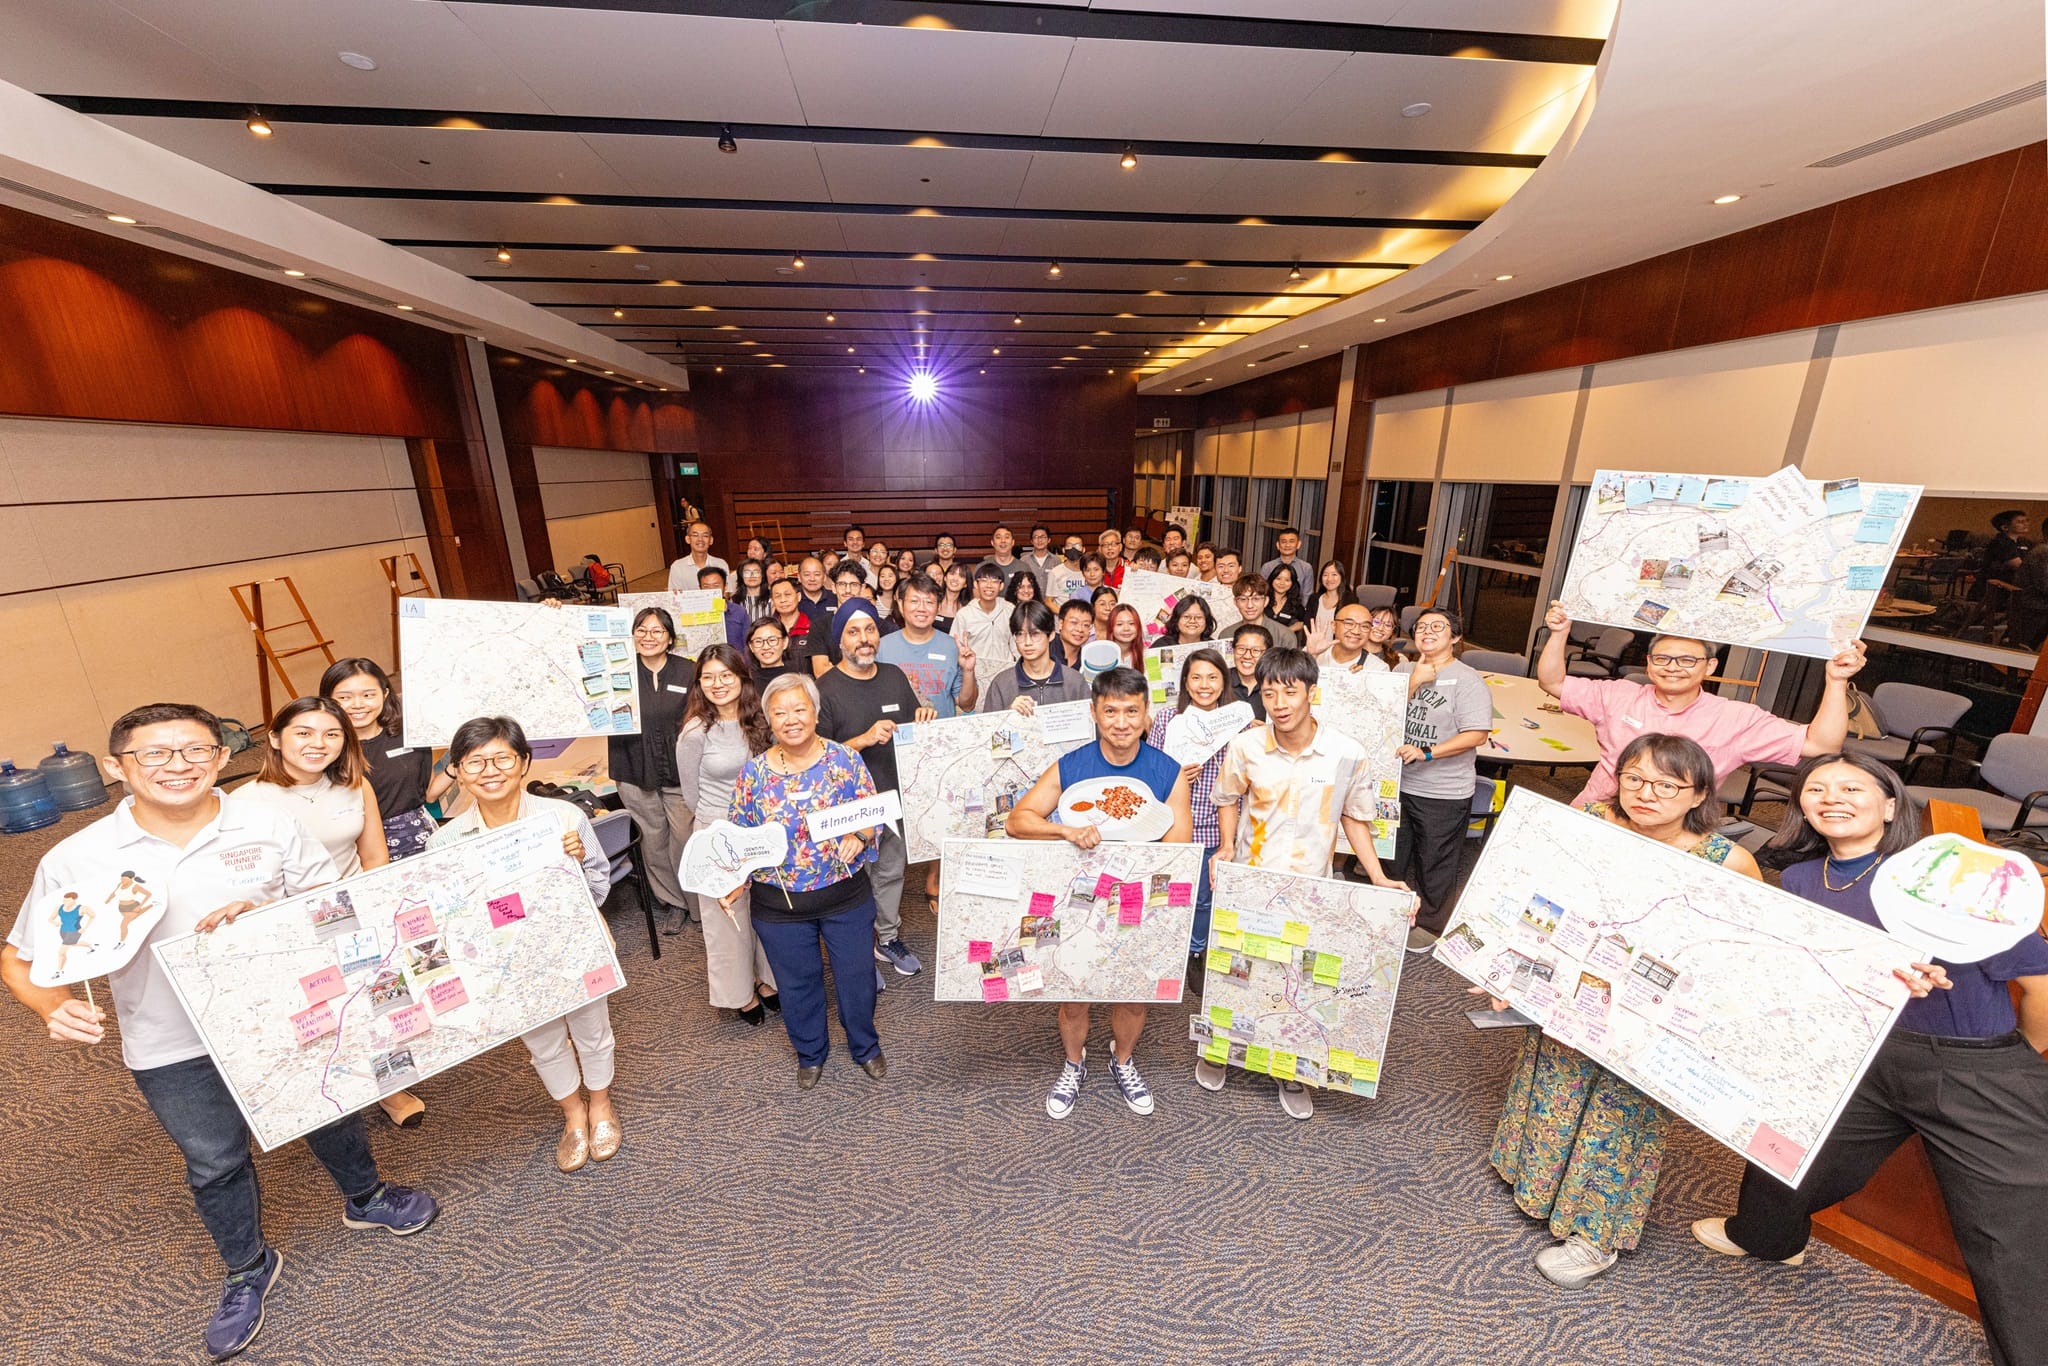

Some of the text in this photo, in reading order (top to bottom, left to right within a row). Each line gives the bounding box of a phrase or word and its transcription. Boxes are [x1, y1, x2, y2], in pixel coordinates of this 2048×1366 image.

[1066, 580, 1088, 588] CHIL
[405, 601, 418, 614] 1A
[1406, 720, 1437, 739] IONAL
[820, 805, 885, 830] #InnerRing
[220, 847, 262, 860] SINGAPORE
[224, 854, 261, 867] RUNNERS
[235, 863, 255, 872] CLUB
[309, 975, 332, 990] ACTIVE
